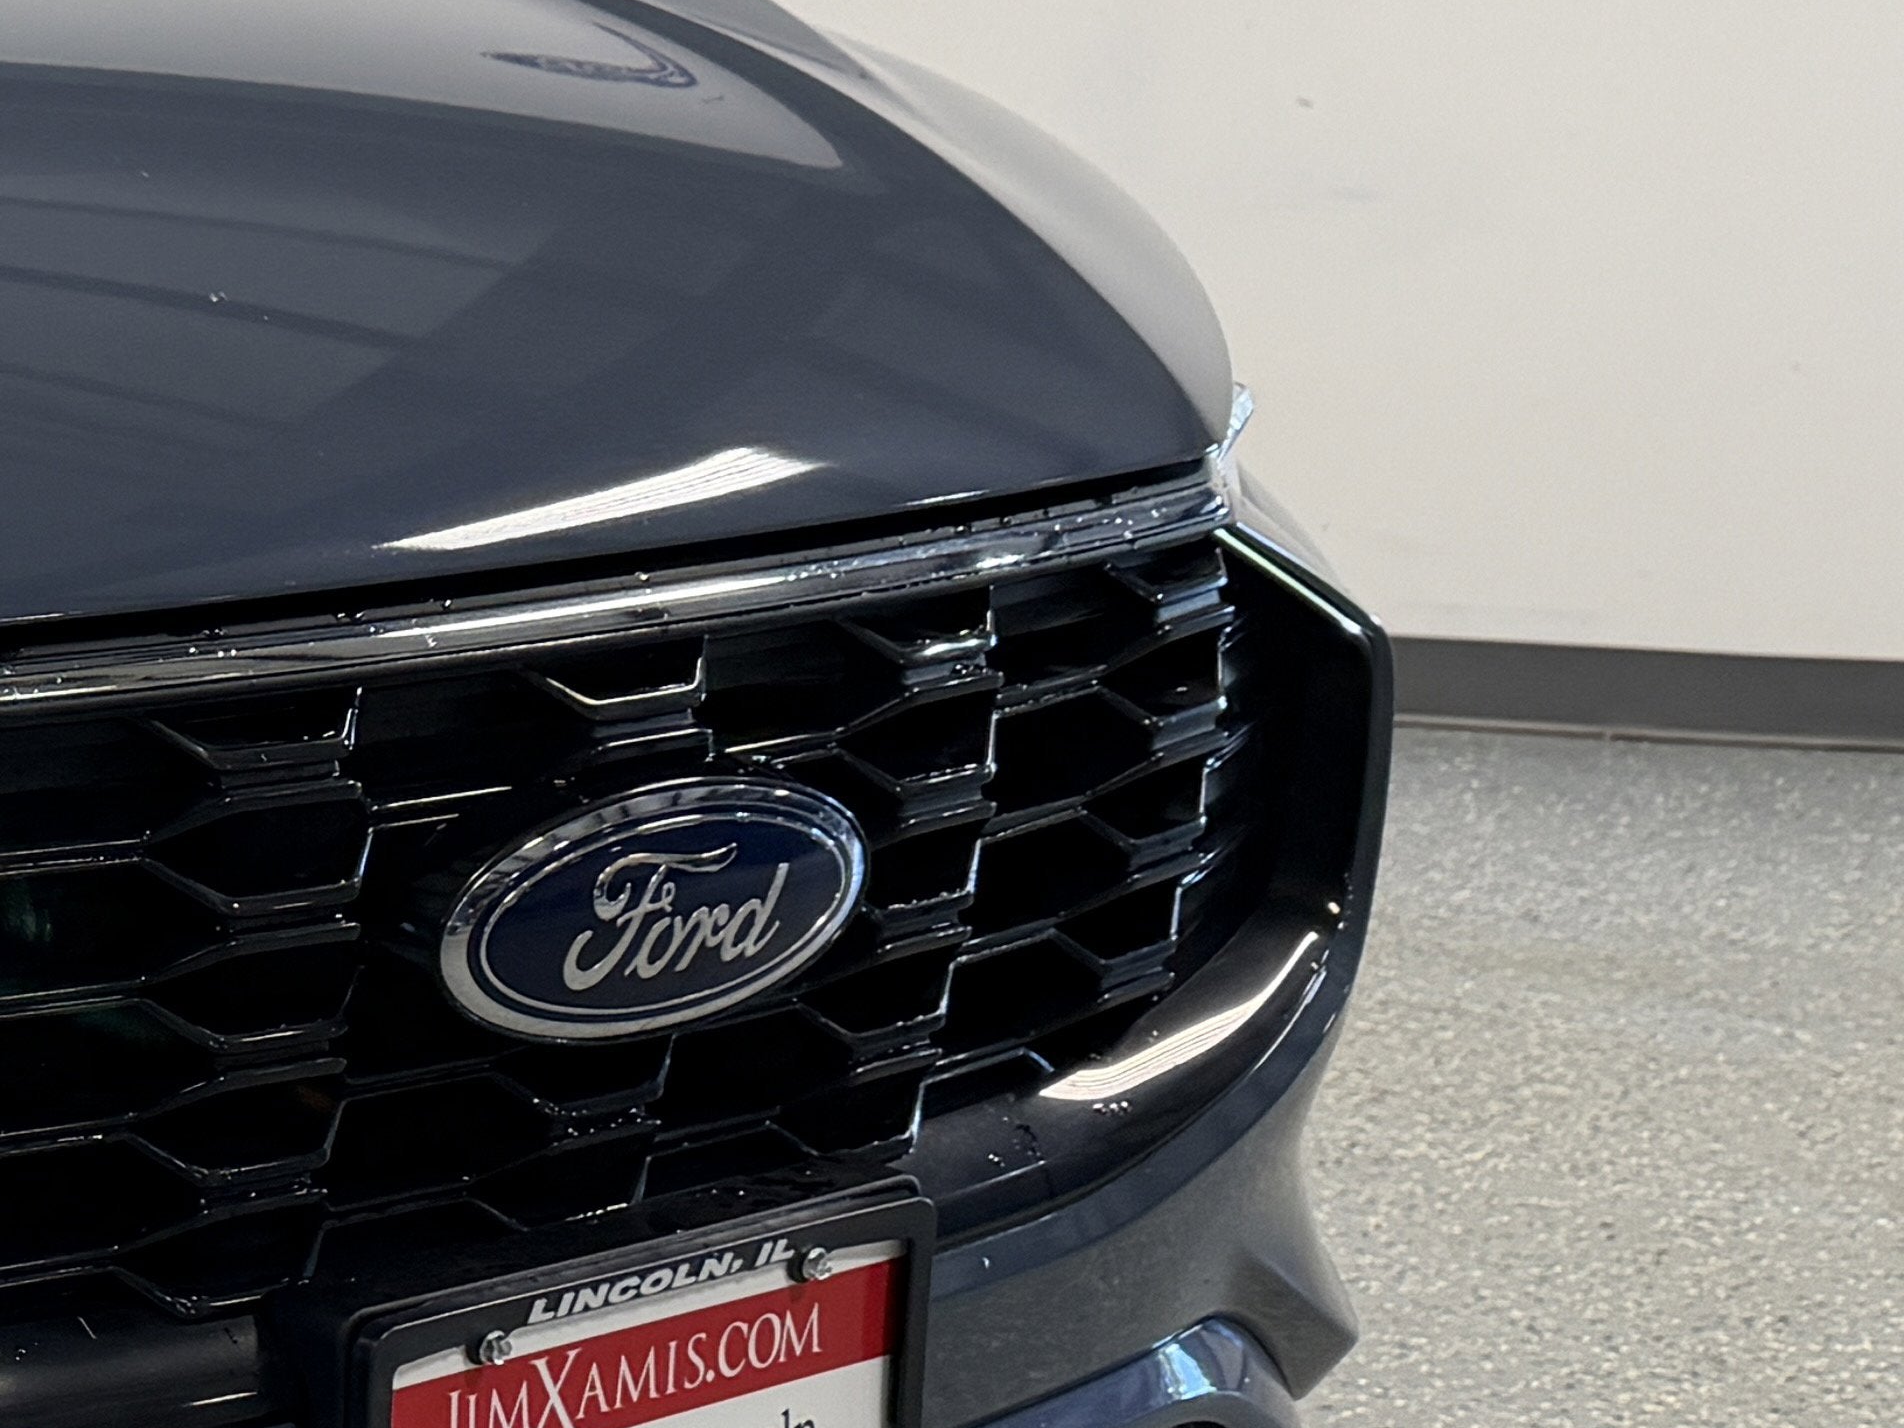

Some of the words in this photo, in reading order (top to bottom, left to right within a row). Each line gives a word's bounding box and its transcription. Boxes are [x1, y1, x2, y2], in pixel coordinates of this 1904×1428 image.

[562, 841, 790, 991] Ford
[527, 1251, 742, 1324] LINCOLN,
[754, 1238, 794, 1268] IL
